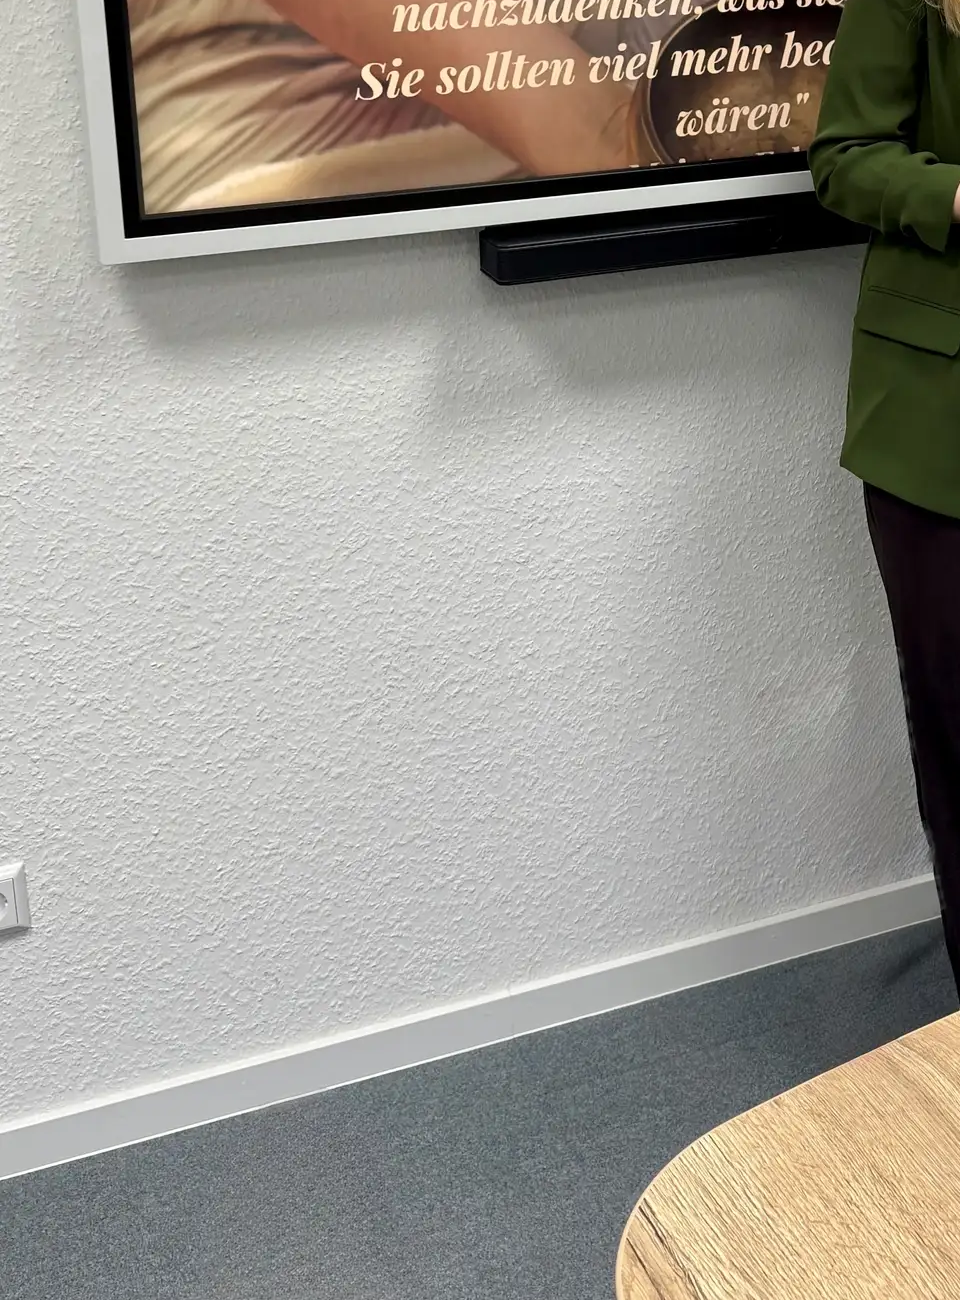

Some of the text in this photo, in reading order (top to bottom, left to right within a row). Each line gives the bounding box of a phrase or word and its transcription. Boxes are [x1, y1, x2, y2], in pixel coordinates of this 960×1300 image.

[355, 58, 426, 102] Sie
[434, 50, 576, 95] sollten
[588, 42, 659, 83] viel
[670, 33, 773, 78] mehr
[676, 92, 810, 138] wären"
